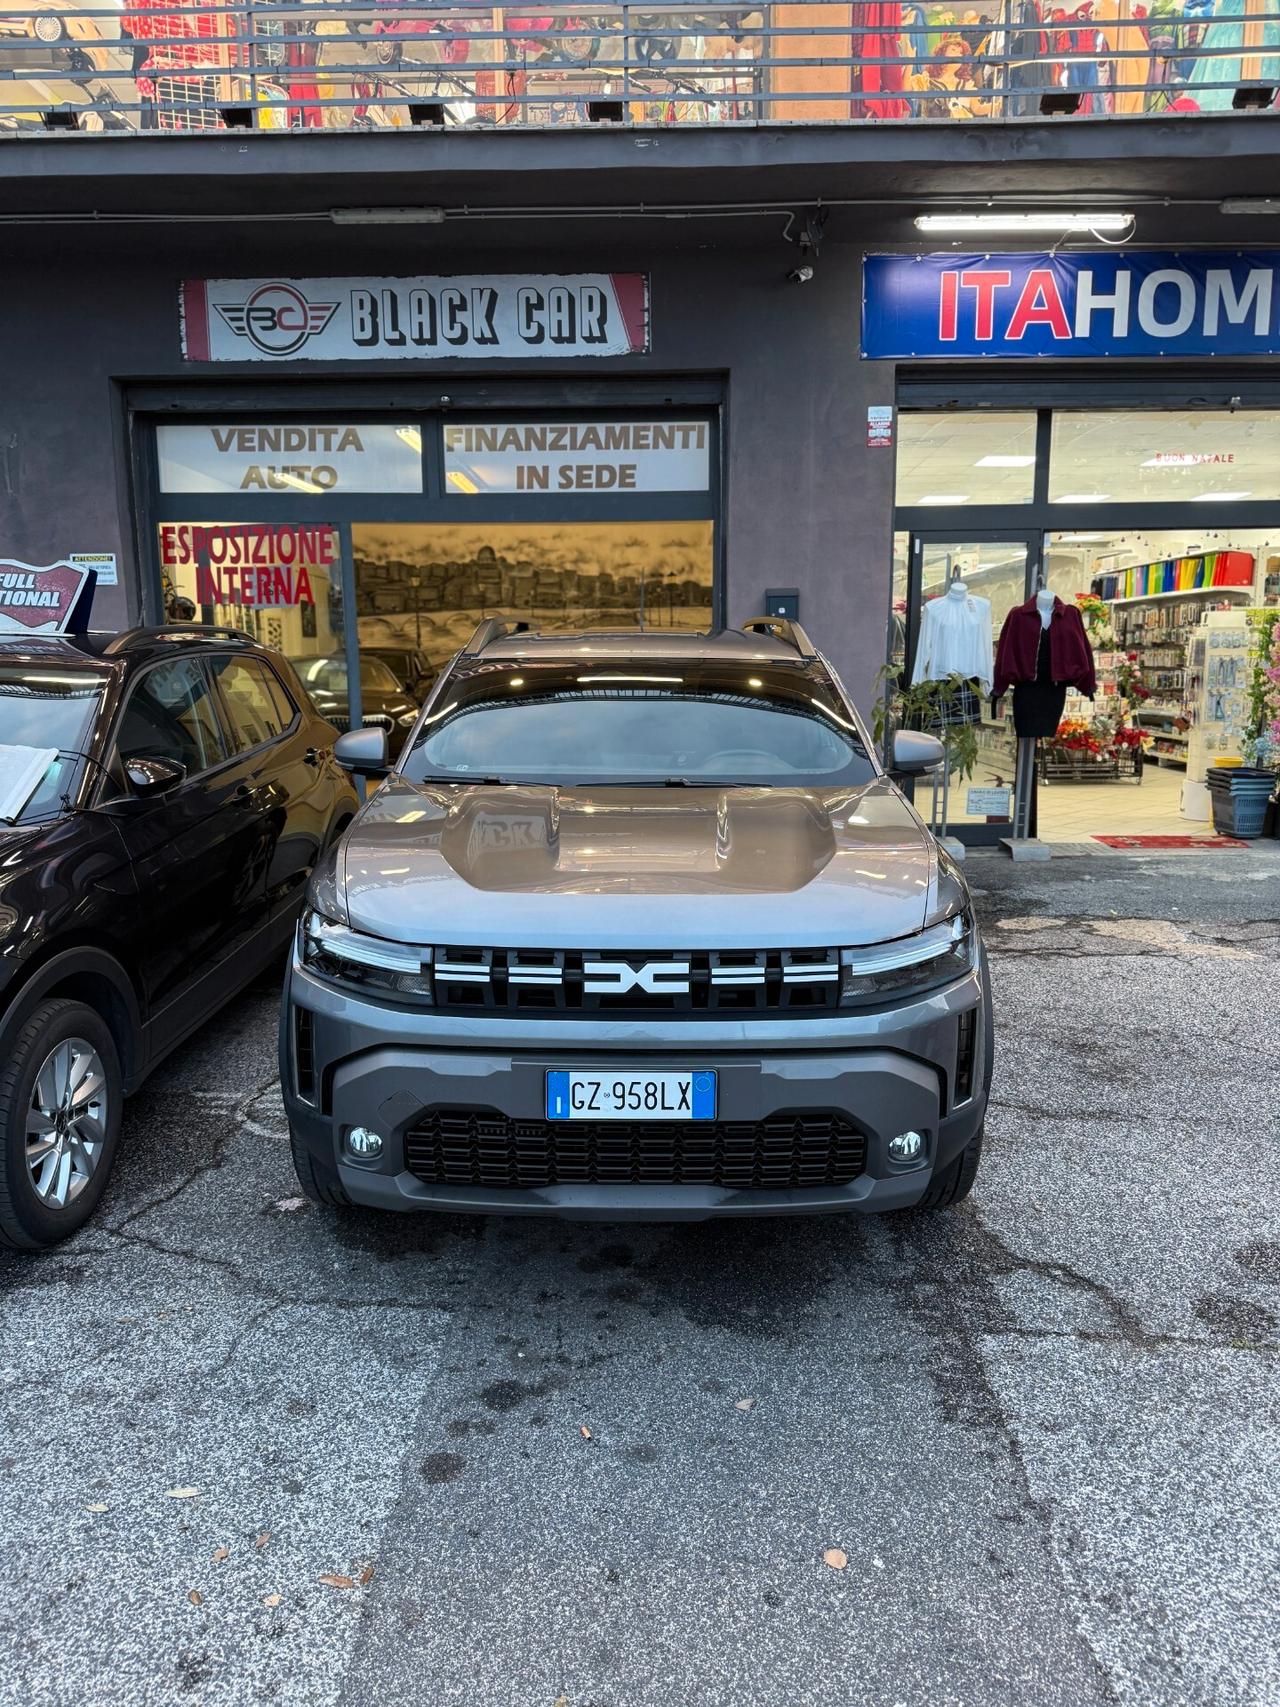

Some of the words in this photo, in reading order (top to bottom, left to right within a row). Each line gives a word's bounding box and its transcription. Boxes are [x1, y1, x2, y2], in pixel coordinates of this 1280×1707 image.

[350, 288, 499, 347] BLACK
[517, 286, 608, 344] CAR
[211, 428, 364, 452] VENDITA
[446, 424, 705, 452] FINANZIAMENTI
[1155, 453, 1185, 463] BUON
[1192, 453, 1234, 464] NATALE
[239, 465, 338, 490] AUTO
[516, 466, 550, 490] IN
[558, 464, 637, 489] SEDE
[161, 525, 335, 564] ESPOSIZIONE
[195, 567, 315, 605] INTERNA
